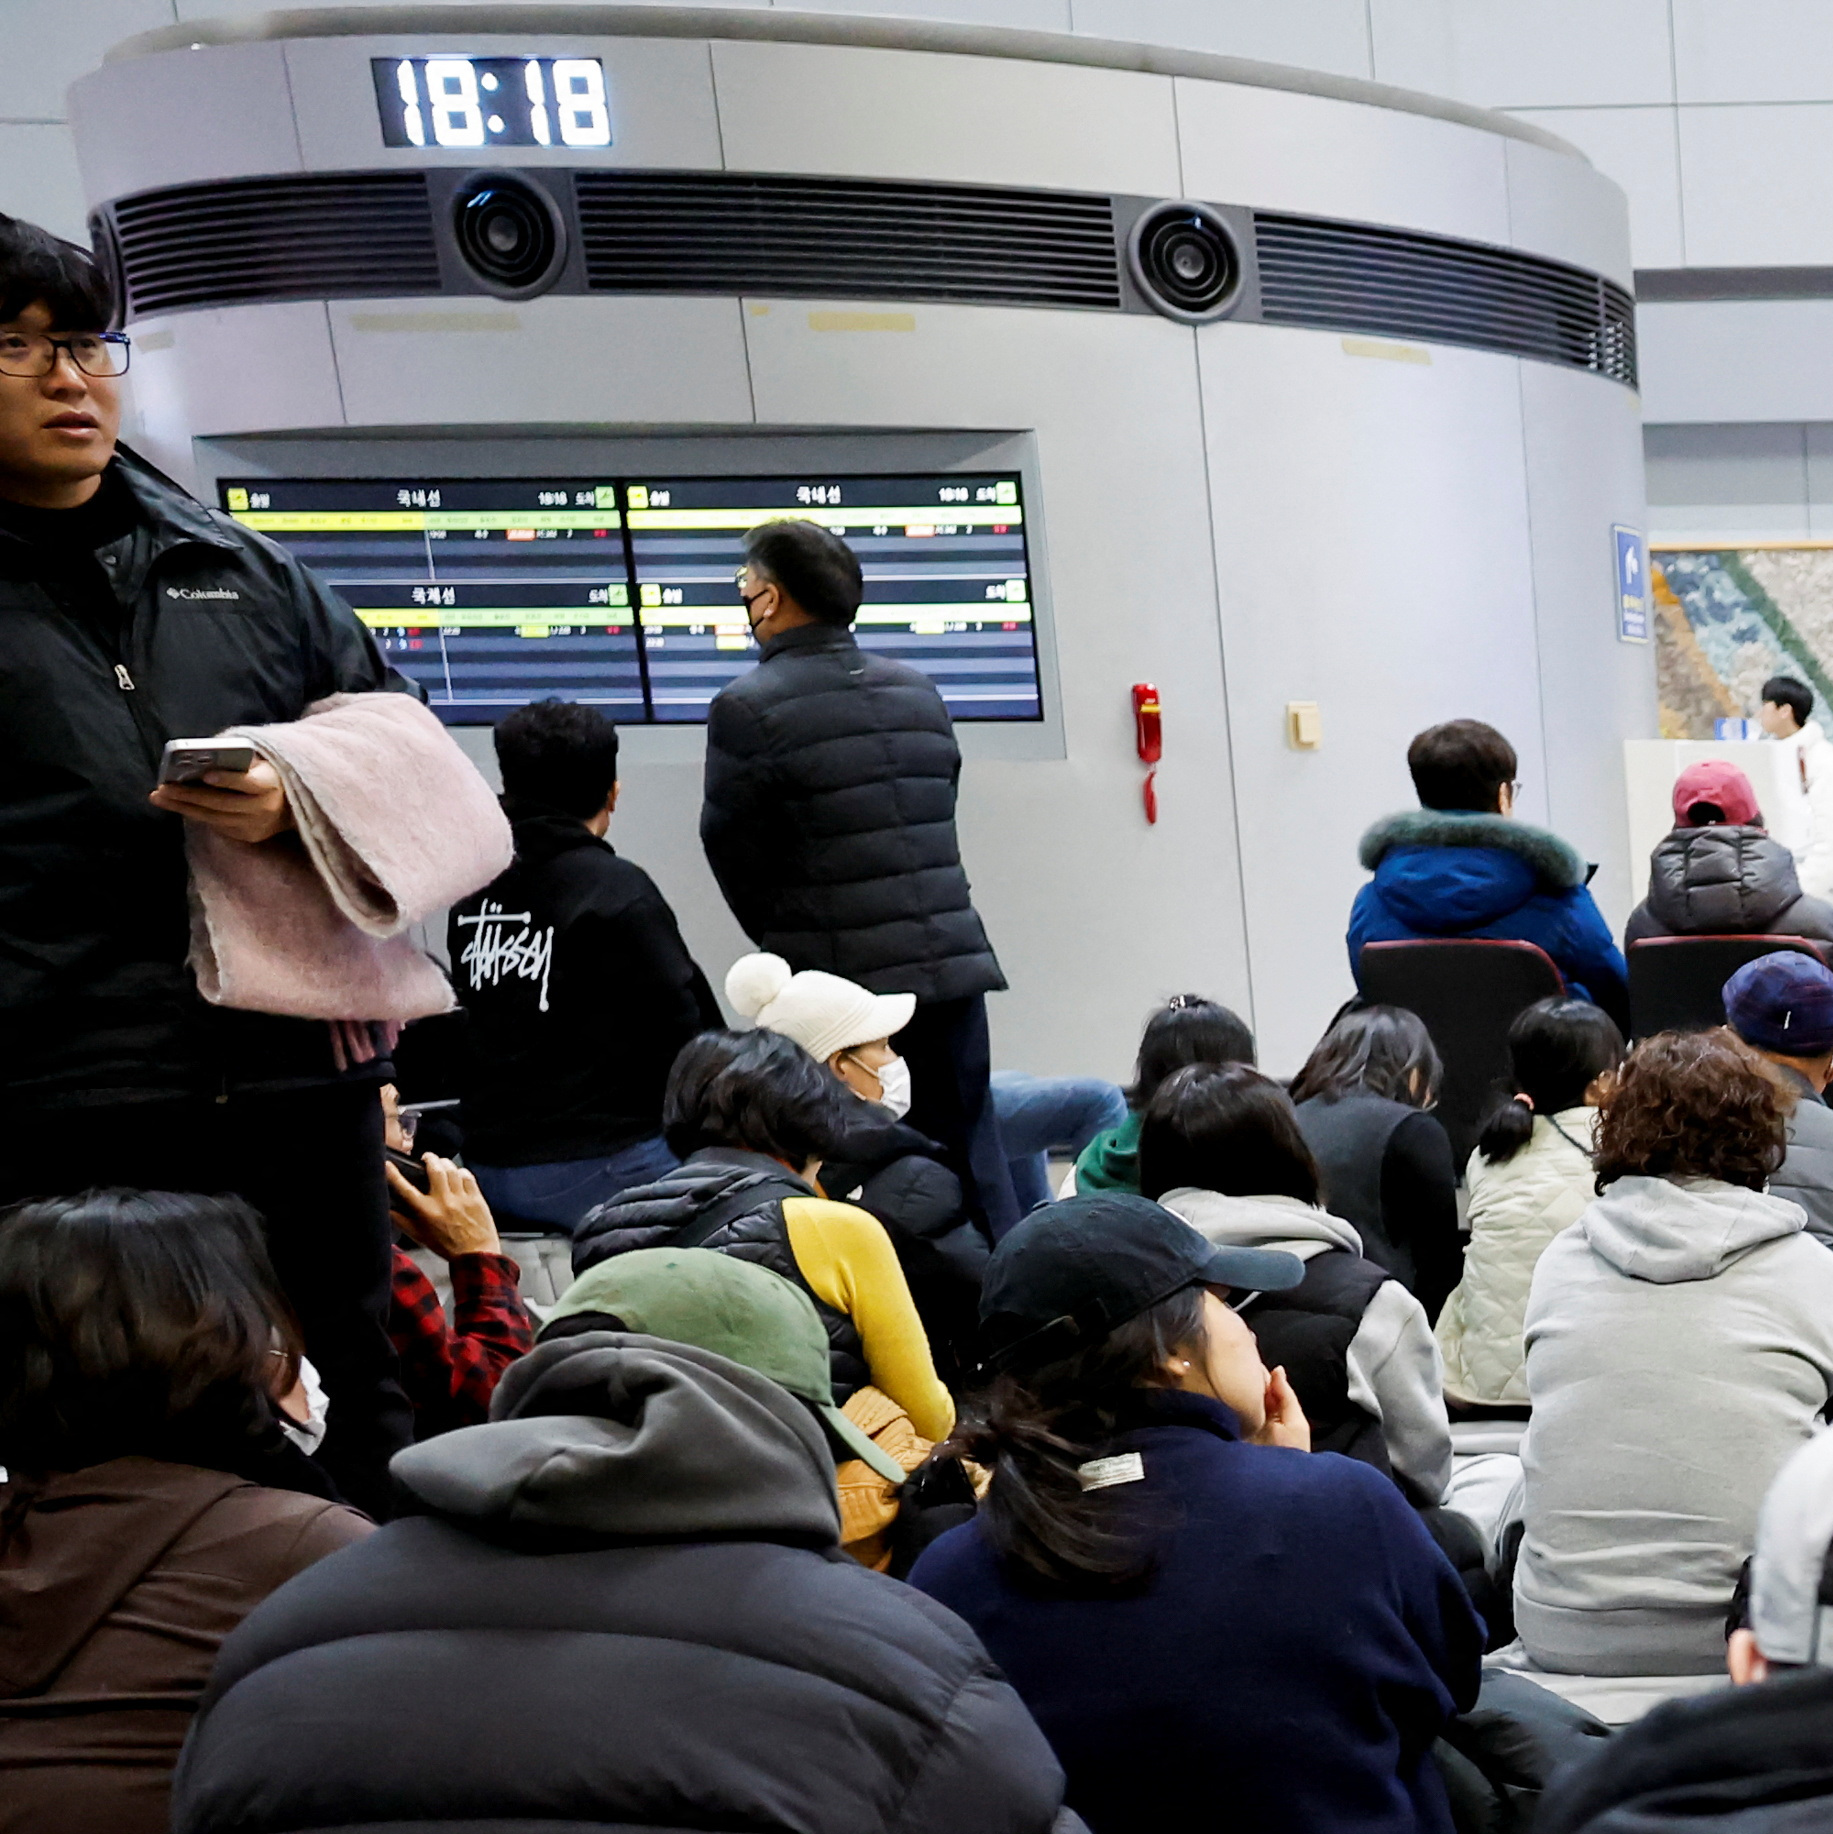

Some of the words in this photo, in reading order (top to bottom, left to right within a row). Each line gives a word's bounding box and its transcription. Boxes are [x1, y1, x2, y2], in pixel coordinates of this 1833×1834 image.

[397, 59, 611, 146] 18:18
[397, 489, 441, 507] 국내선
[538, 492, 567, 506] 18:18
[796, 486, 841, 504] 국내선
[938, 487, 969, 502] 18:18
[180, 587, 239, 600] Columbia
[411, 588, 456, 605] 국제선
